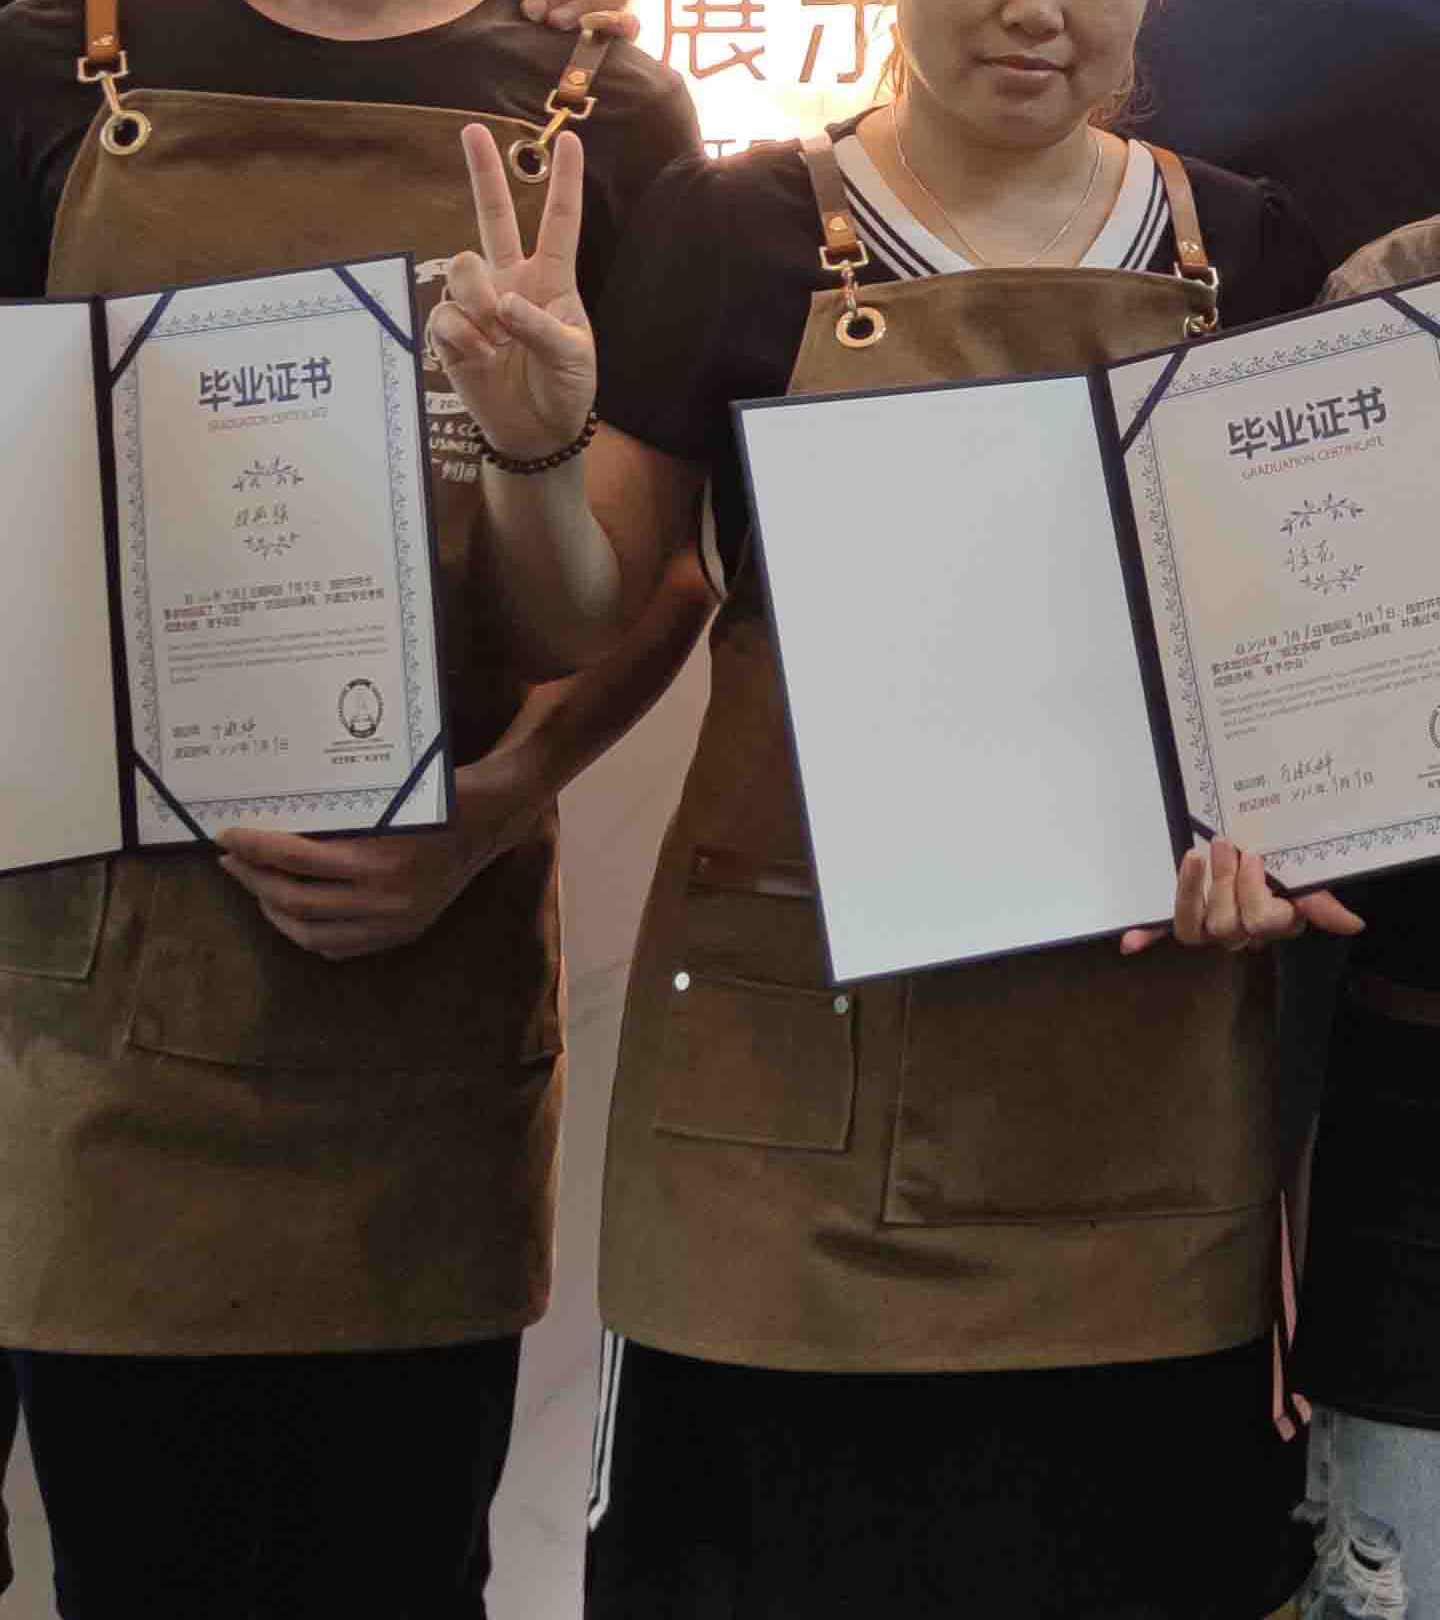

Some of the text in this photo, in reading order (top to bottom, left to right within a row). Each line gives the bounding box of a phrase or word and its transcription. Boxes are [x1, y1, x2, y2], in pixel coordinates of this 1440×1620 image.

[197, 355, 334, 413] 毕业证书
[1227, 386, 1388, 460] 毕业证书
